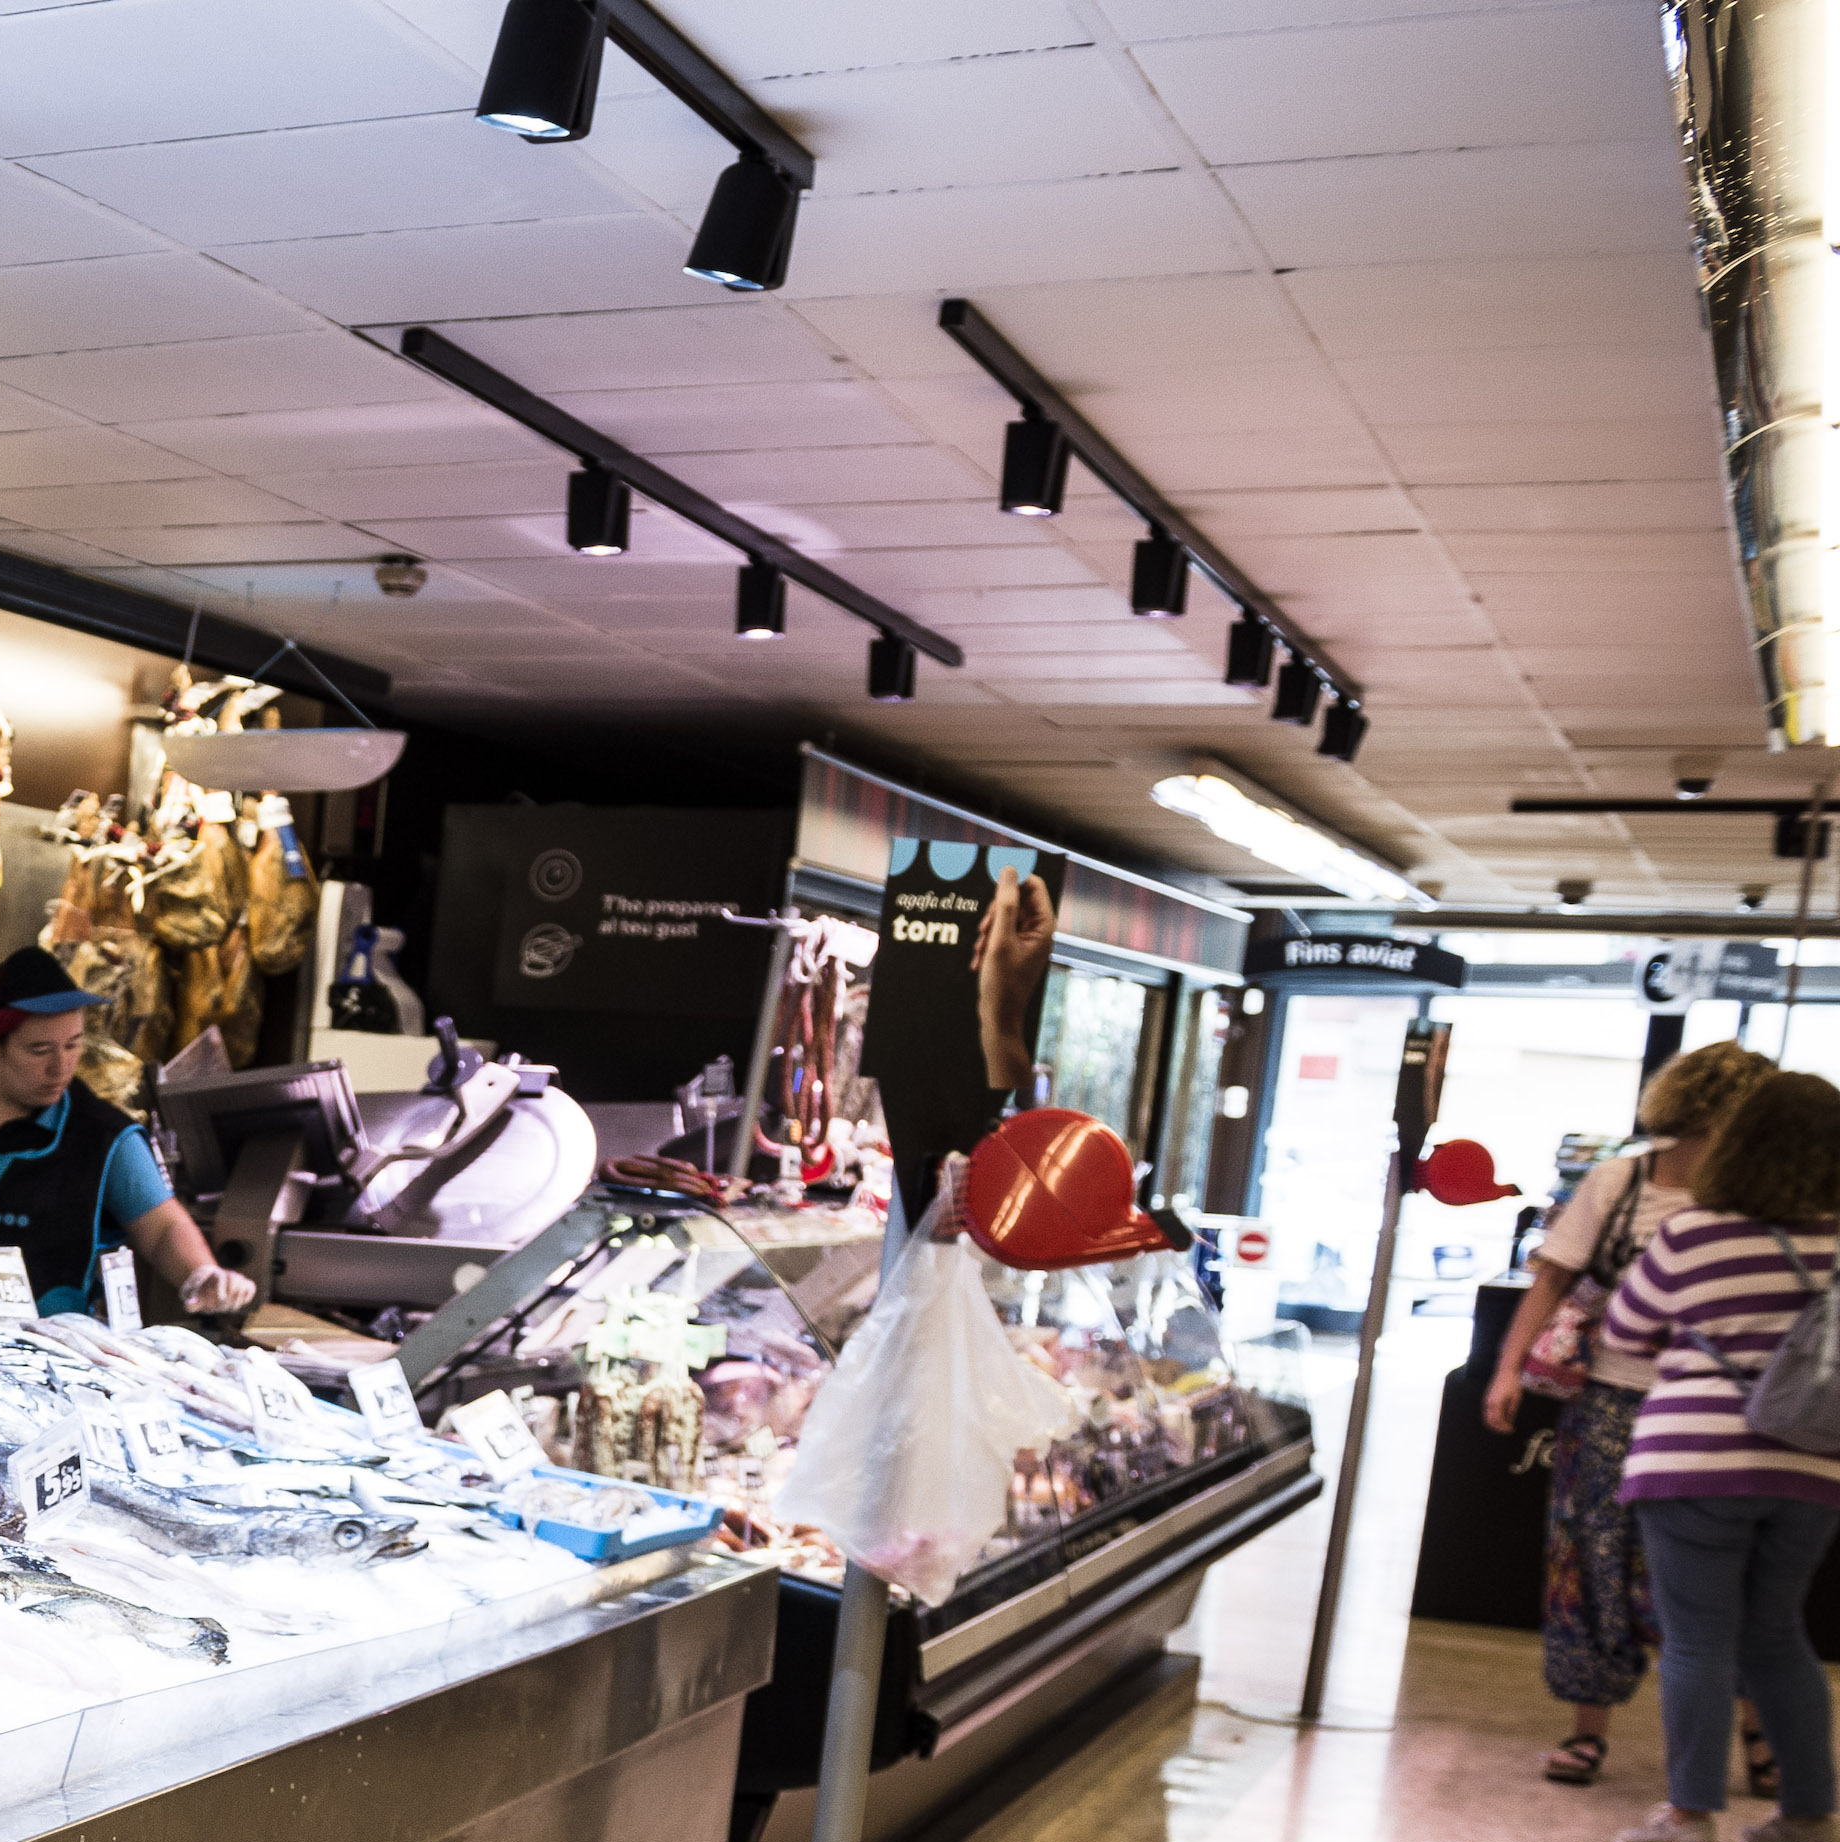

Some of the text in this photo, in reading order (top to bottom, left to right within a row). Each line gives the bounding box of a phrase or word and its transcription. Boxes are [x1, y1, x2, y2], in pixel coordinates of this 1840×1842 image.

[896, 891, 979, 912] agafa el teu
[892, 915, 960, 945] torn
[1285, 940, 1417, 972] Fins aviat
